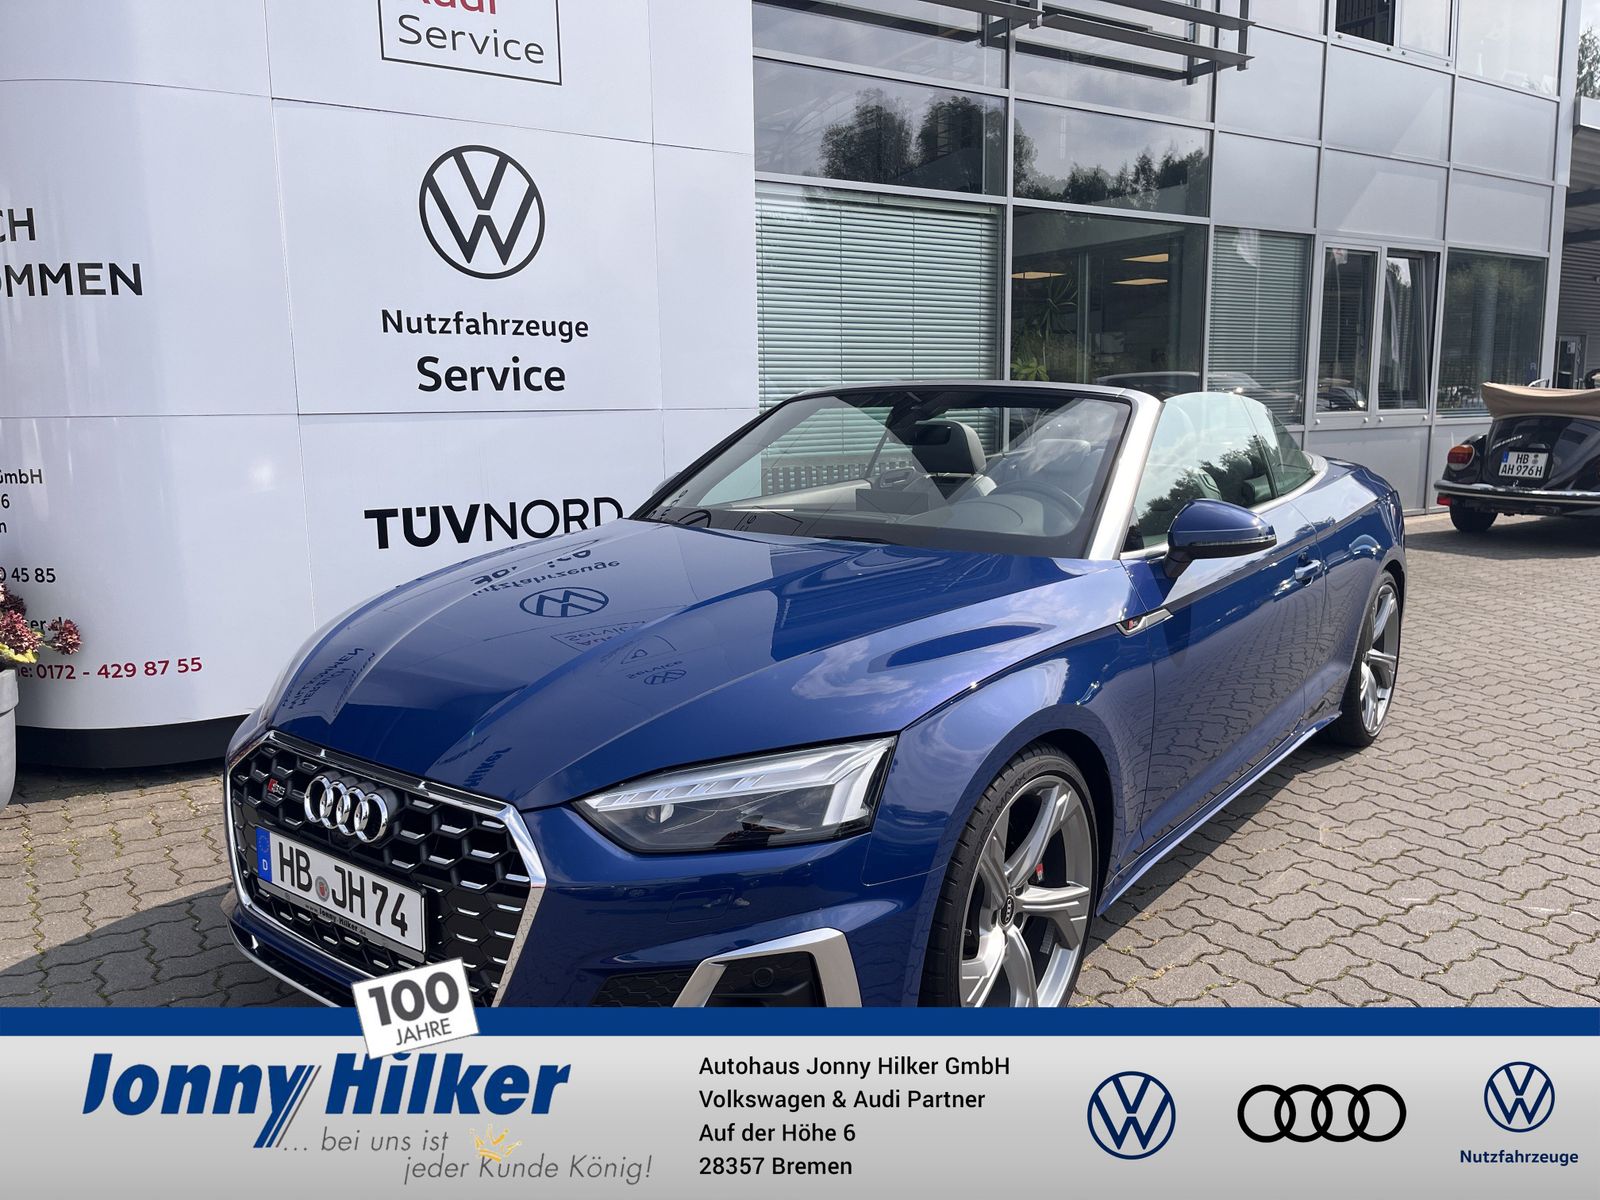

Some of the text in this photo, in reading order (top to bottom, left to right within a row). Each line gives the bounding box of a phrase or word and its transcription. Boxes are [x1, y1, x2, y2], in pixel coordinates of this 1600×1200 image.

[398, 14, 544, 64] Service
[0, 207, 36, 242] H
[0, 263, 143, 297] MMEN
[381, 309, 589, 343] Nutzfahrzeuge
[416, 355, 566, 392] Service
[1516, 453, 1530, 464] HB
[1, 493, 10, 509] 6
[11, 567, 30, 583] 45
[34, 567, 56, 583] 85
[36, 664, 76, 679] 0172
[97, 663, 137, 679] 429
[144, 659, 170, 676] 87
[177, 656, 203, 674] 55
[278, 842, 313, 893] HB
